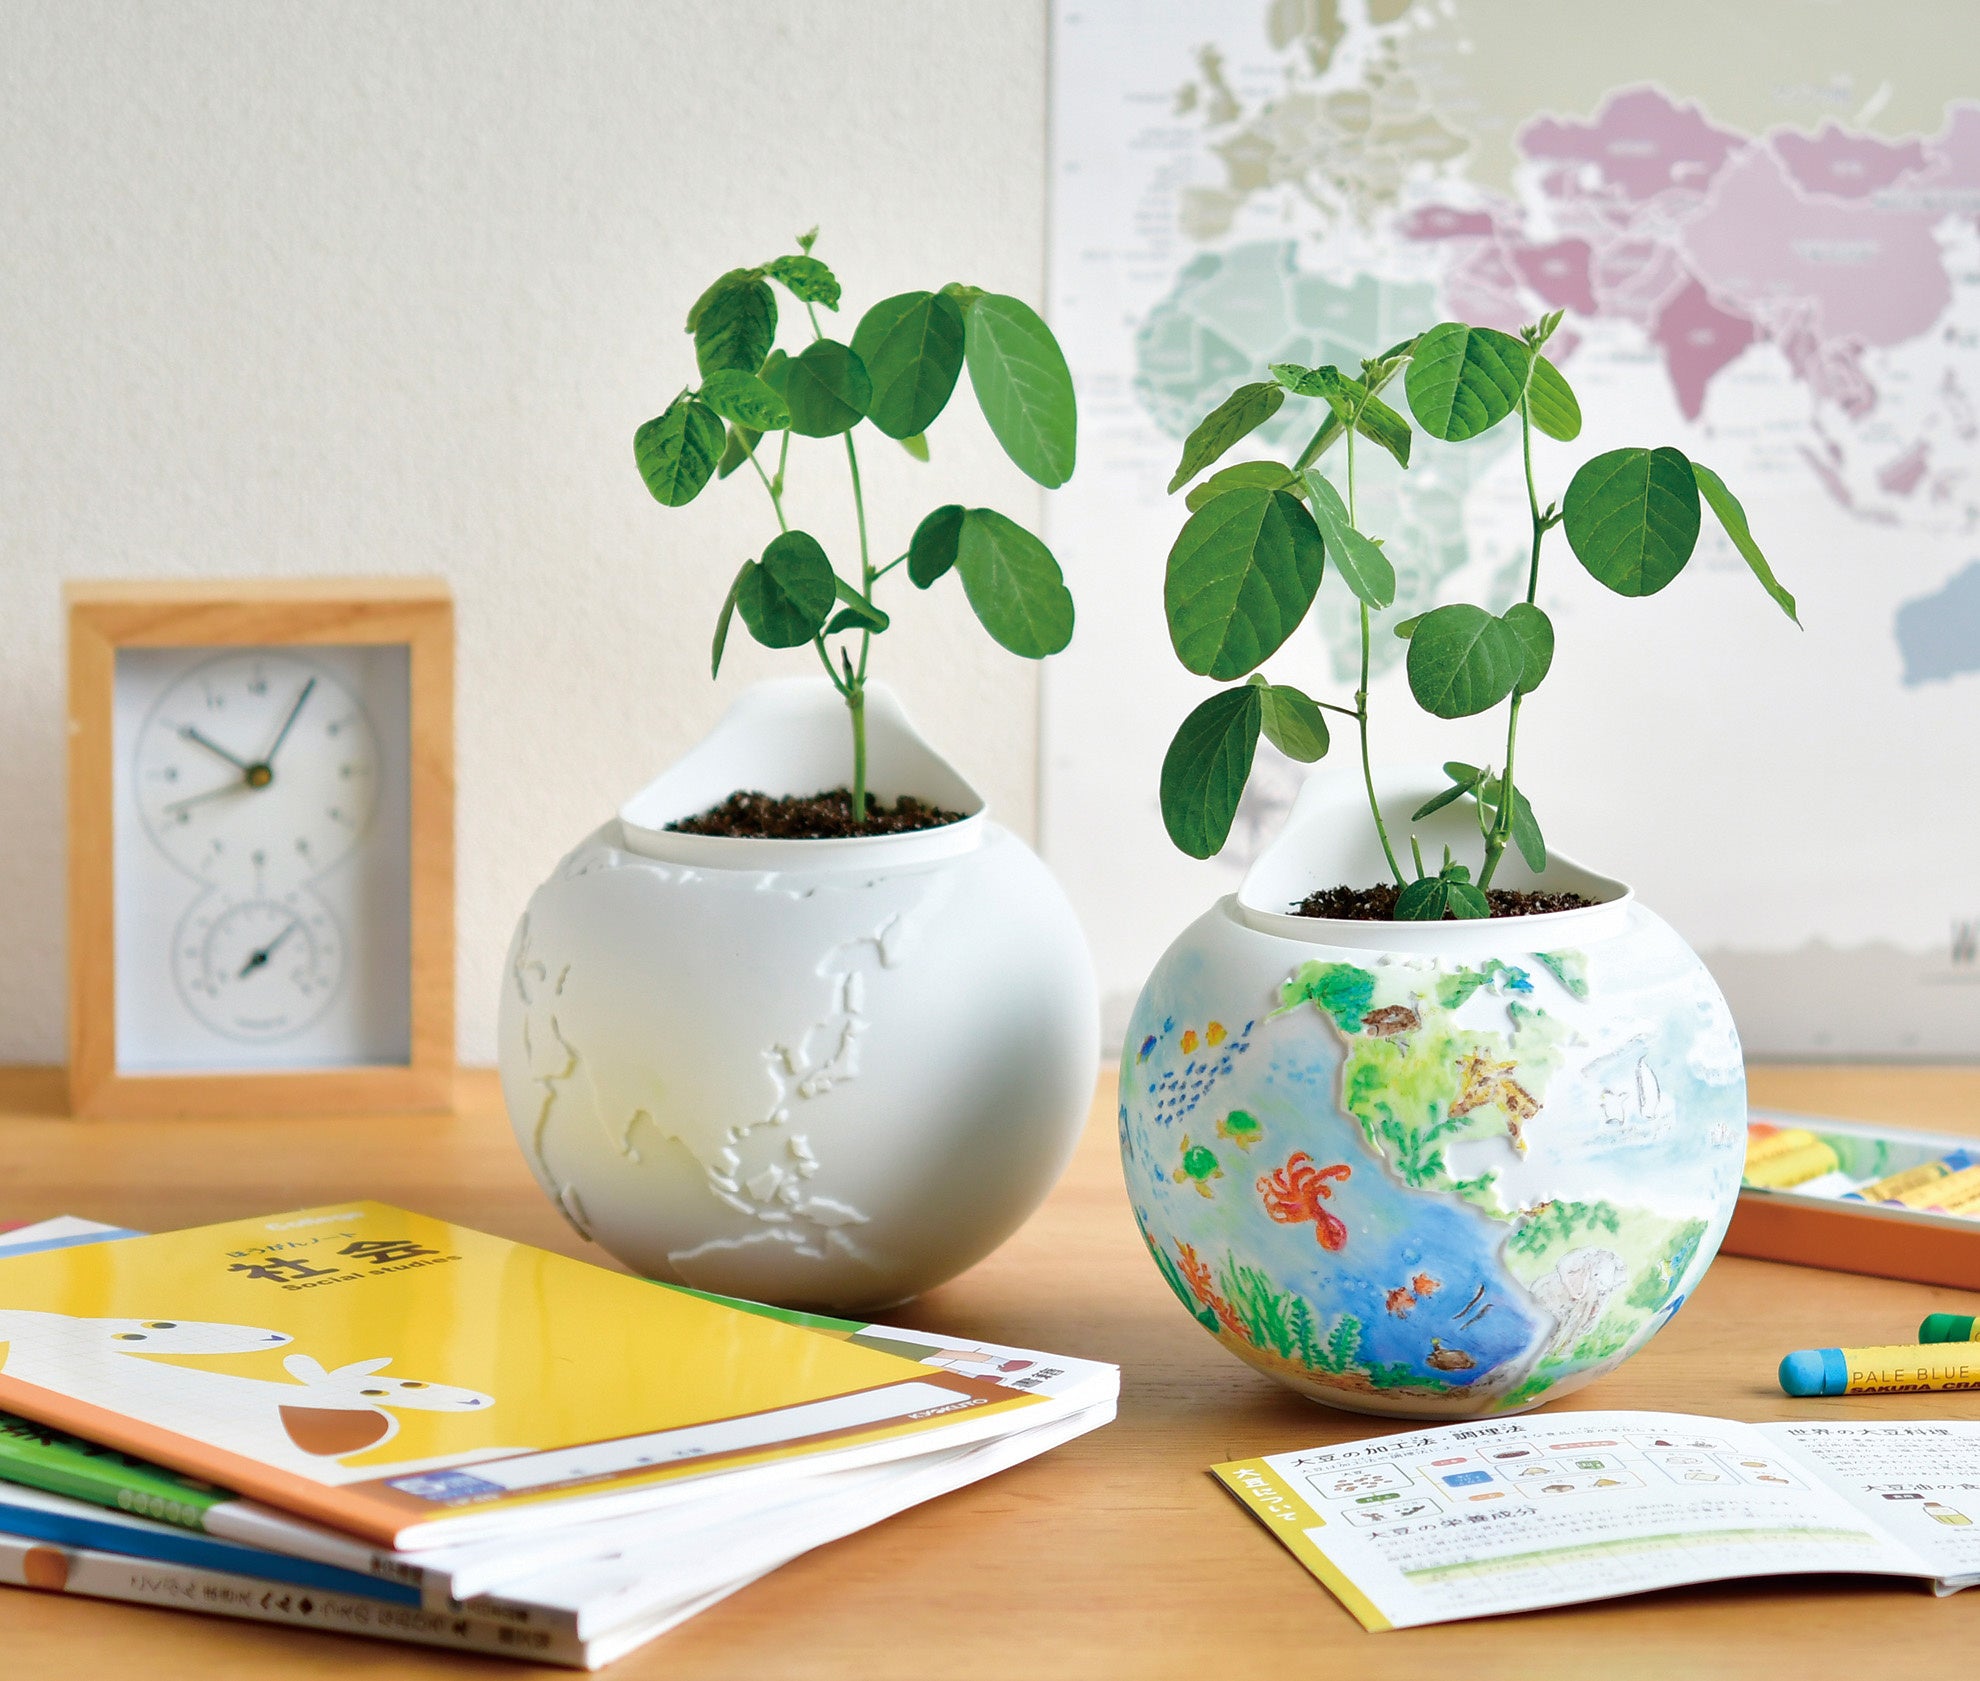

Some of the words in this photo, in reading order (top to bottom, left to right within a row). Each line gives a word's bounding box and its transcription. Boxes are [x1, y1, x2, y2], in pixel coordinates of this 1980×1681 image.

[281, 1272, 365, 1291] Social
[368, 1254, 462, 1276] studies
[1852, 1368, 1905, 1385] PALE
[1917, 1365, 1969, 1381] BLUE
[1850, 1383, 1931, 1393] SAKURA
[1787, 1428, 1953, 1436] 世界の大豆料理
[1232, 1467, 1297, 1522] 大豆について
